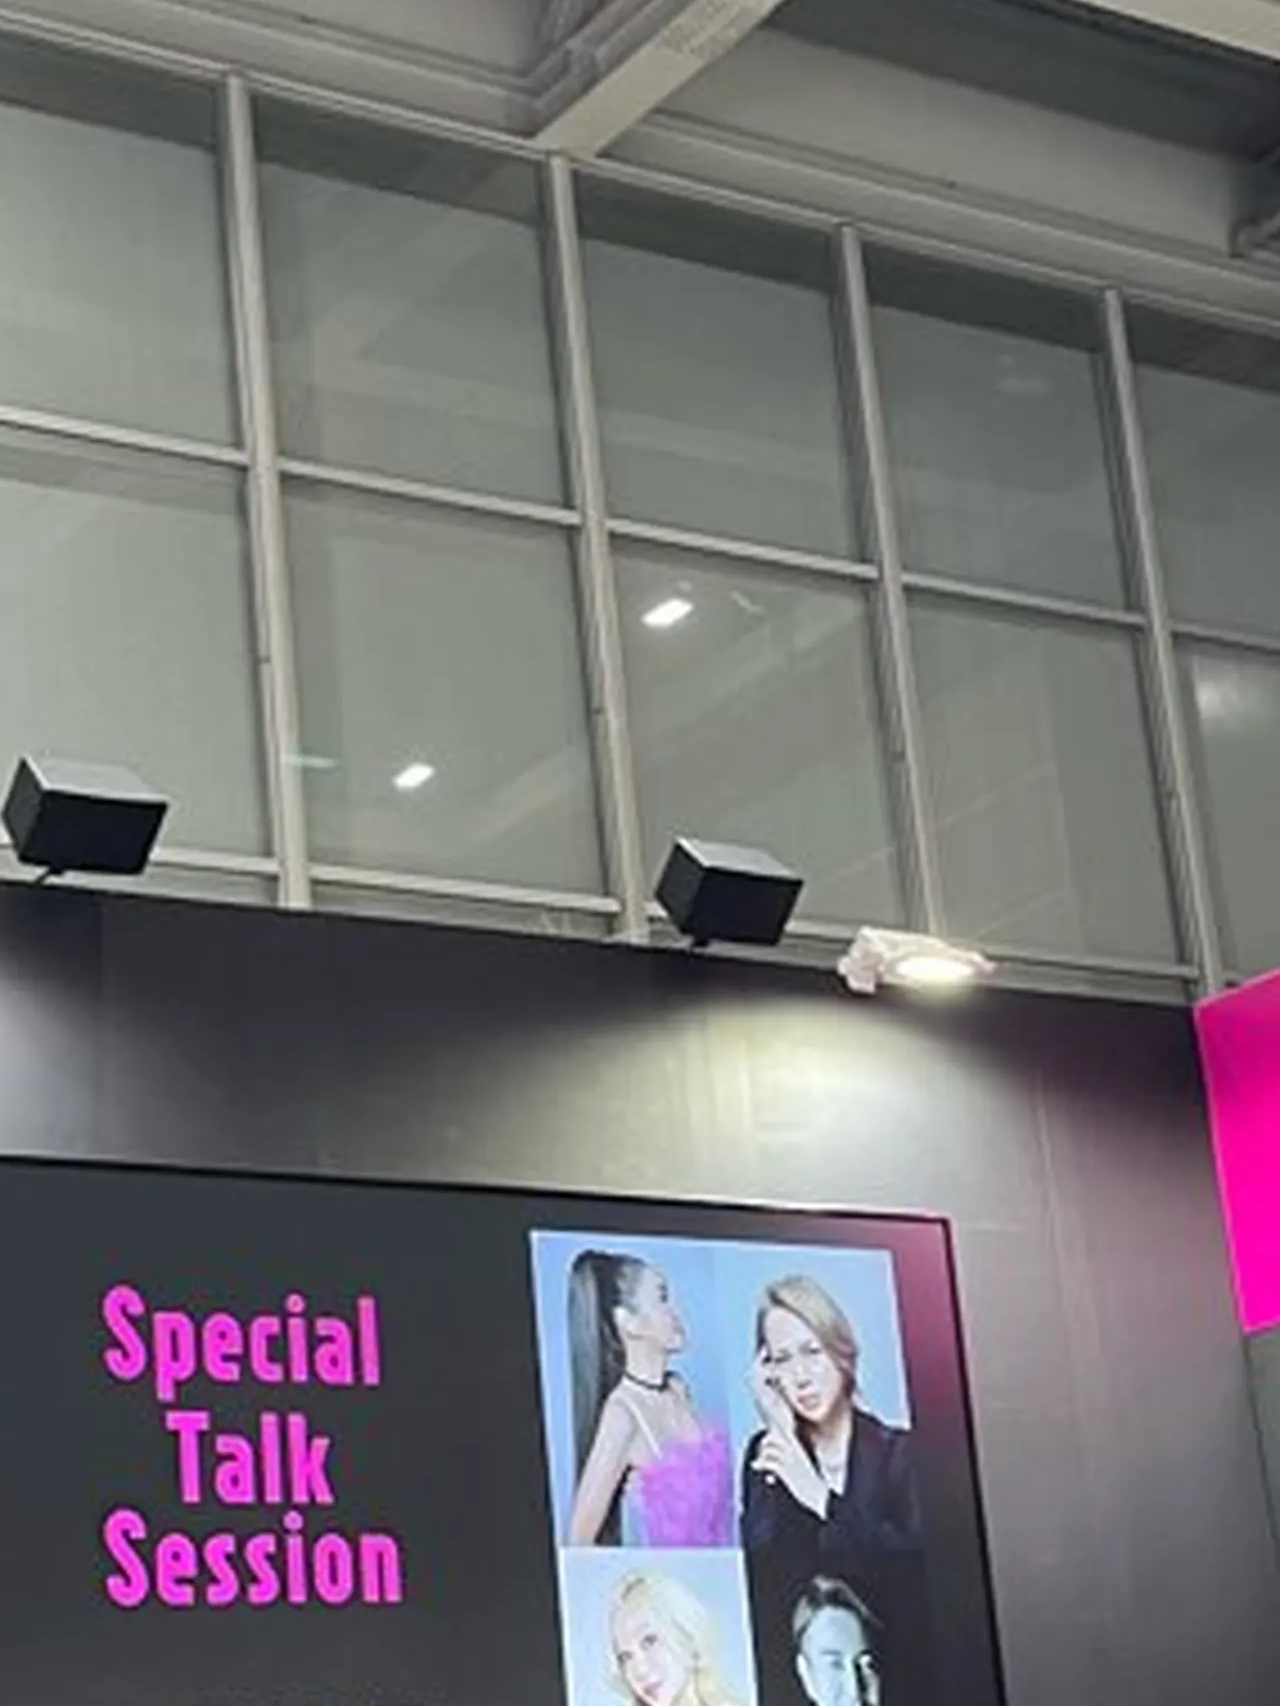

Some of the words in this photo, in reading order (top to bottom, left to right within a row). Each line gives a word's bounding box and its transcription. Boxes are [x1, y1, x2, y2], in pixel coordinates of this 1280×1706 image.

[104, 1285, 381, 1402] Special
[166, 1410, 335, 1505] Talk
[104, 1509, 403, 1607] Session
